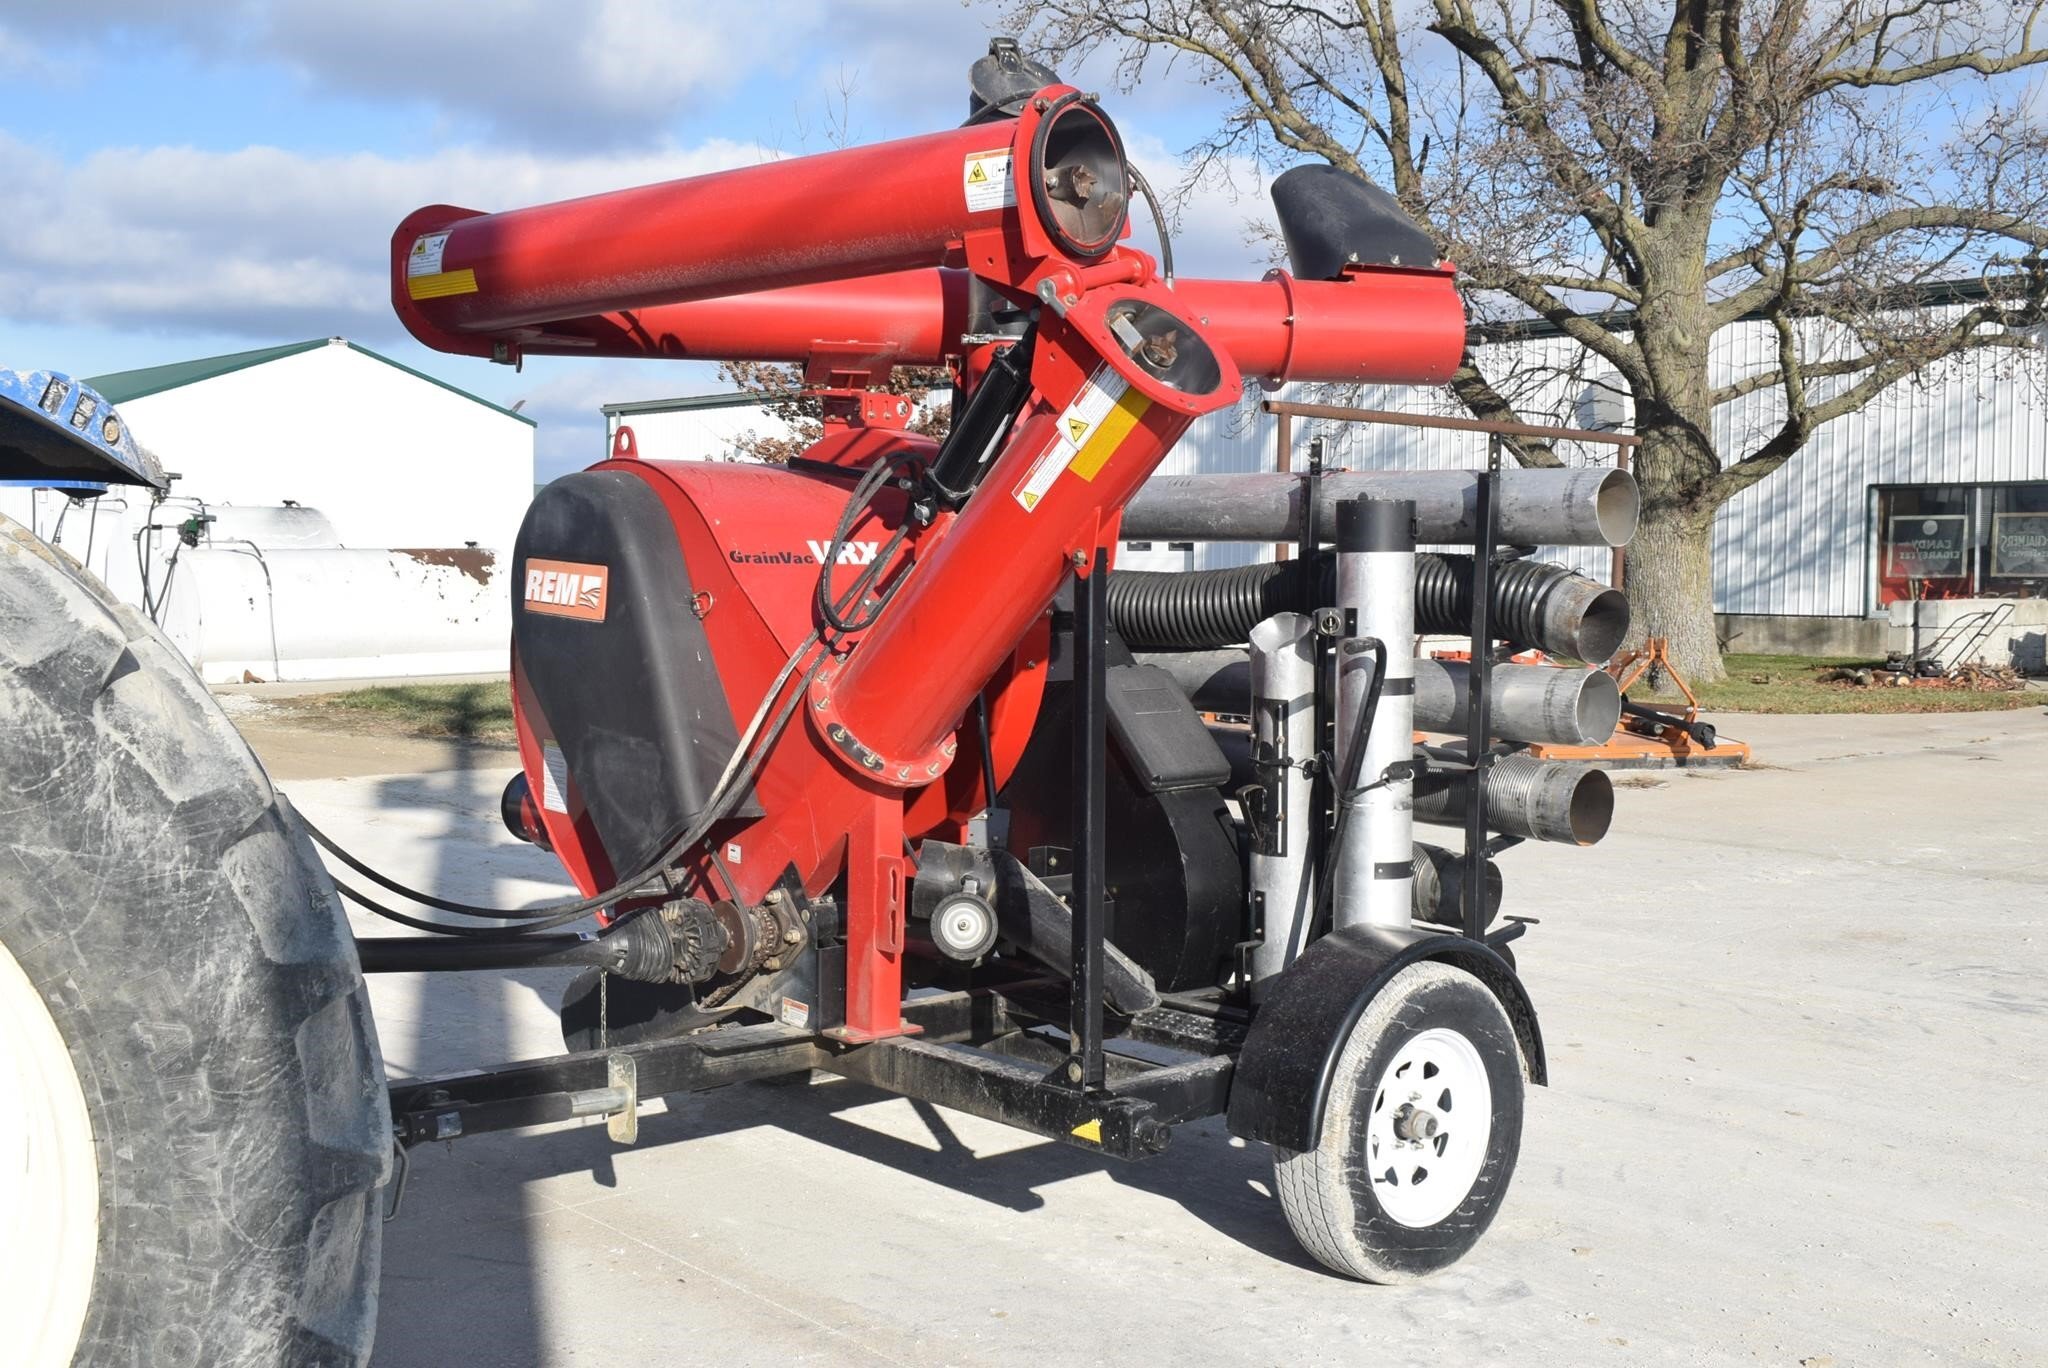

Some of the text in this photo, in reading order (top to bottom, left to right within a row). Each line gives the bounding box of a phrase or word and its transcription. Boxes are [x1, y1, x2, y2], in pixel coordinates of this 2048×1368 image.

[729, 540, 880, 565] GrainVac VRX
[525, 569, 580, 607] REM
